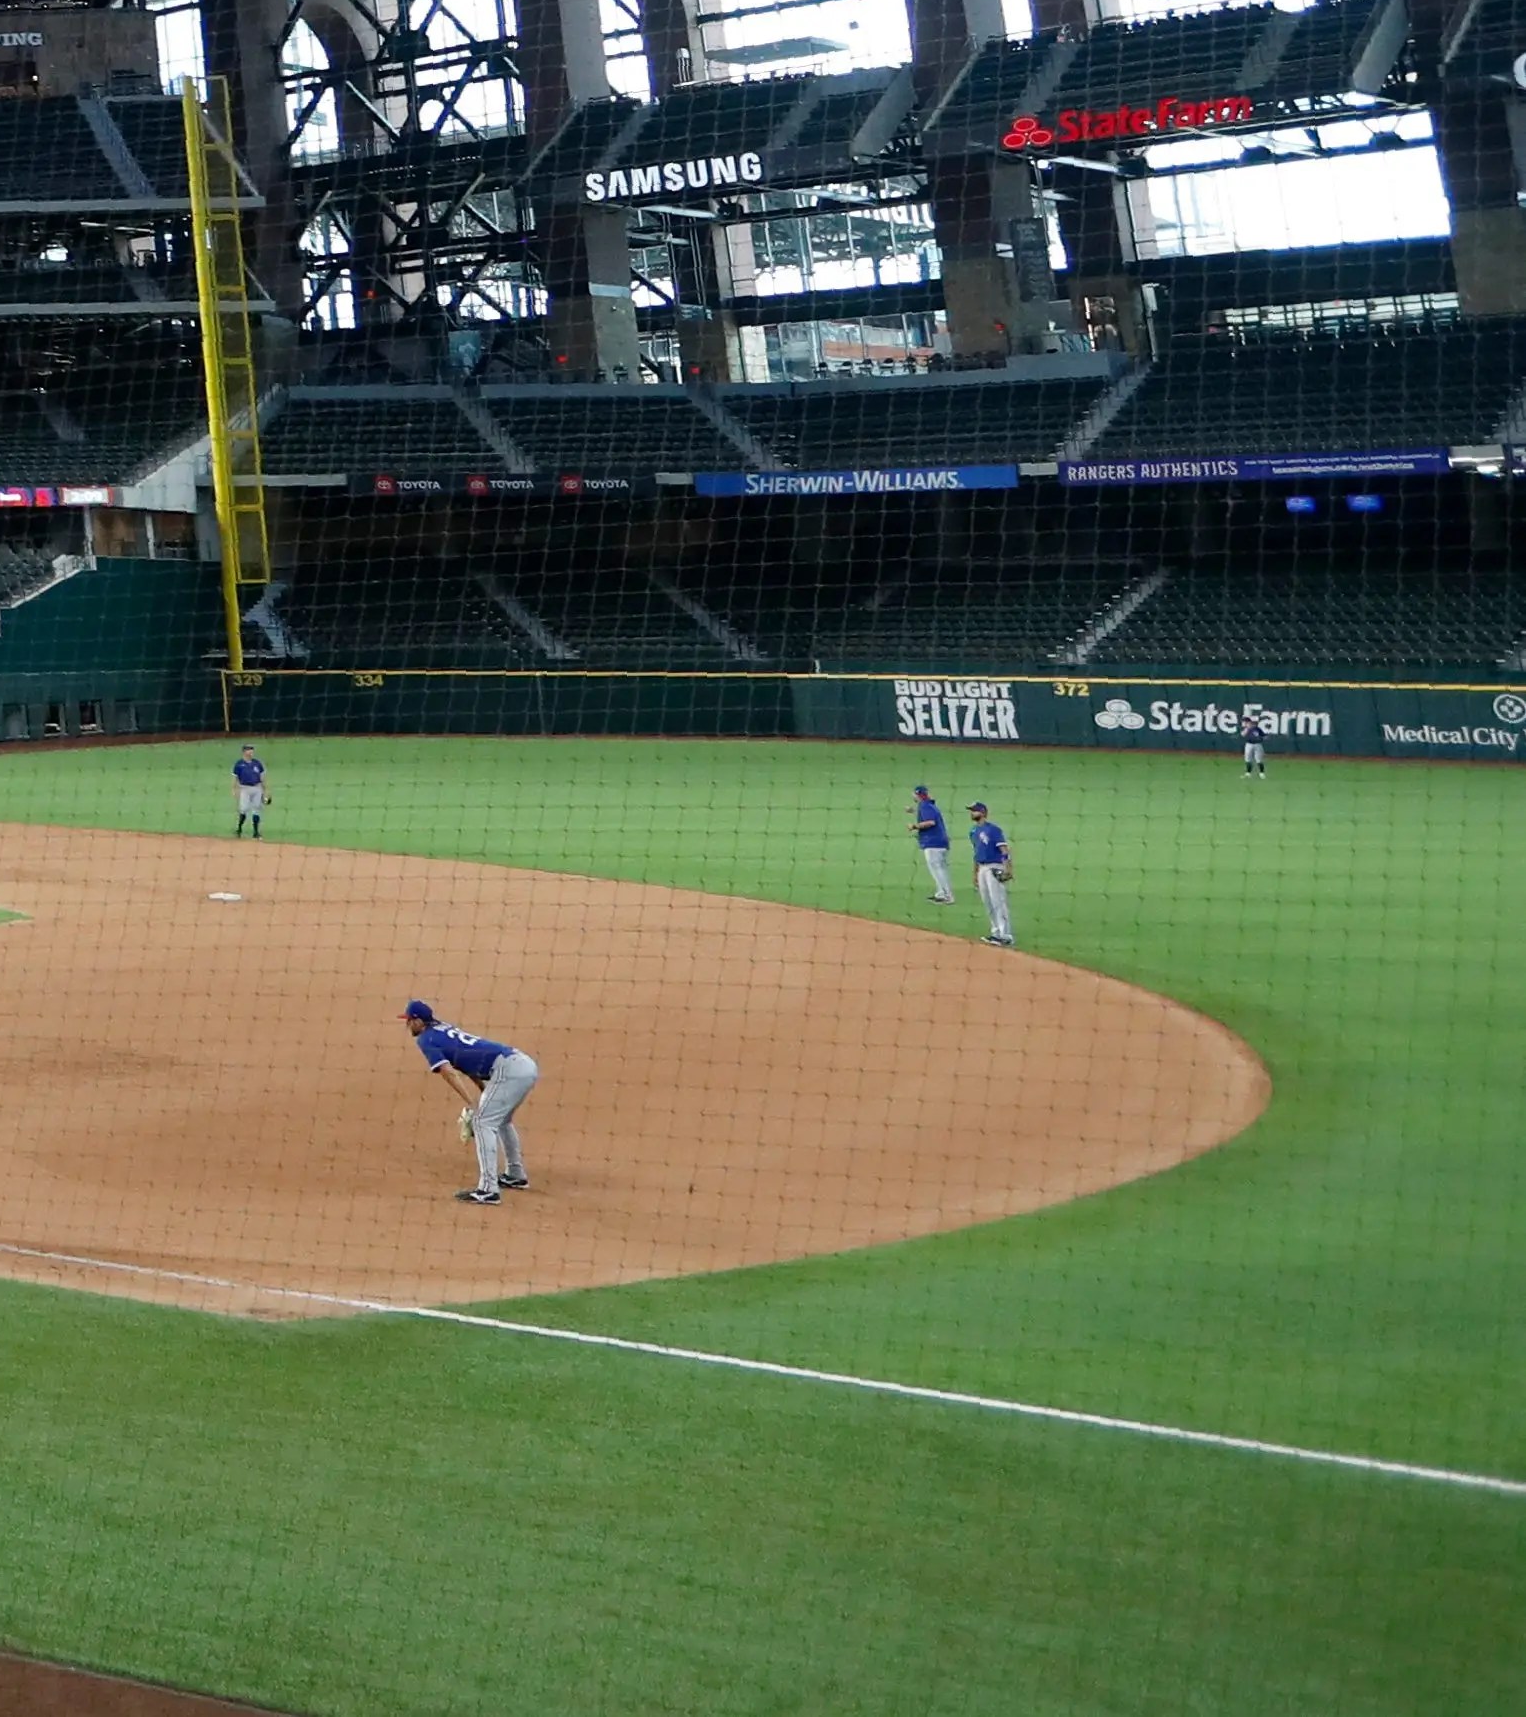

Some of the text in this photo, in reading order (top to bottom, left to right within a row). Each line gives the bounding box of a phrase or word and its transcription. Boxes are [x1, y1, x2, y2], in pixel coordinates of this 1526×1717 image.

[1057, 95, 1251, 143] State Farm
[585, 152, 763, 202] SAMSUNG
[1068, 461, 1239, 481] RANGERS AUTHENTICS
[397, 479, 441, 491] TOYOTA
[490, 479, 534, 491] TOYOTA
[584, 478, 629, 490] TOYOTA
[894, 679, 1012, 699] BUD LIGHT
[1054, 682, 1090, 698] 372
[896, 696, 1020, 740] SELTZER
[1149, 700, 1331, 736] State Farm
[1382, 724, 1519, 752] Medical City
